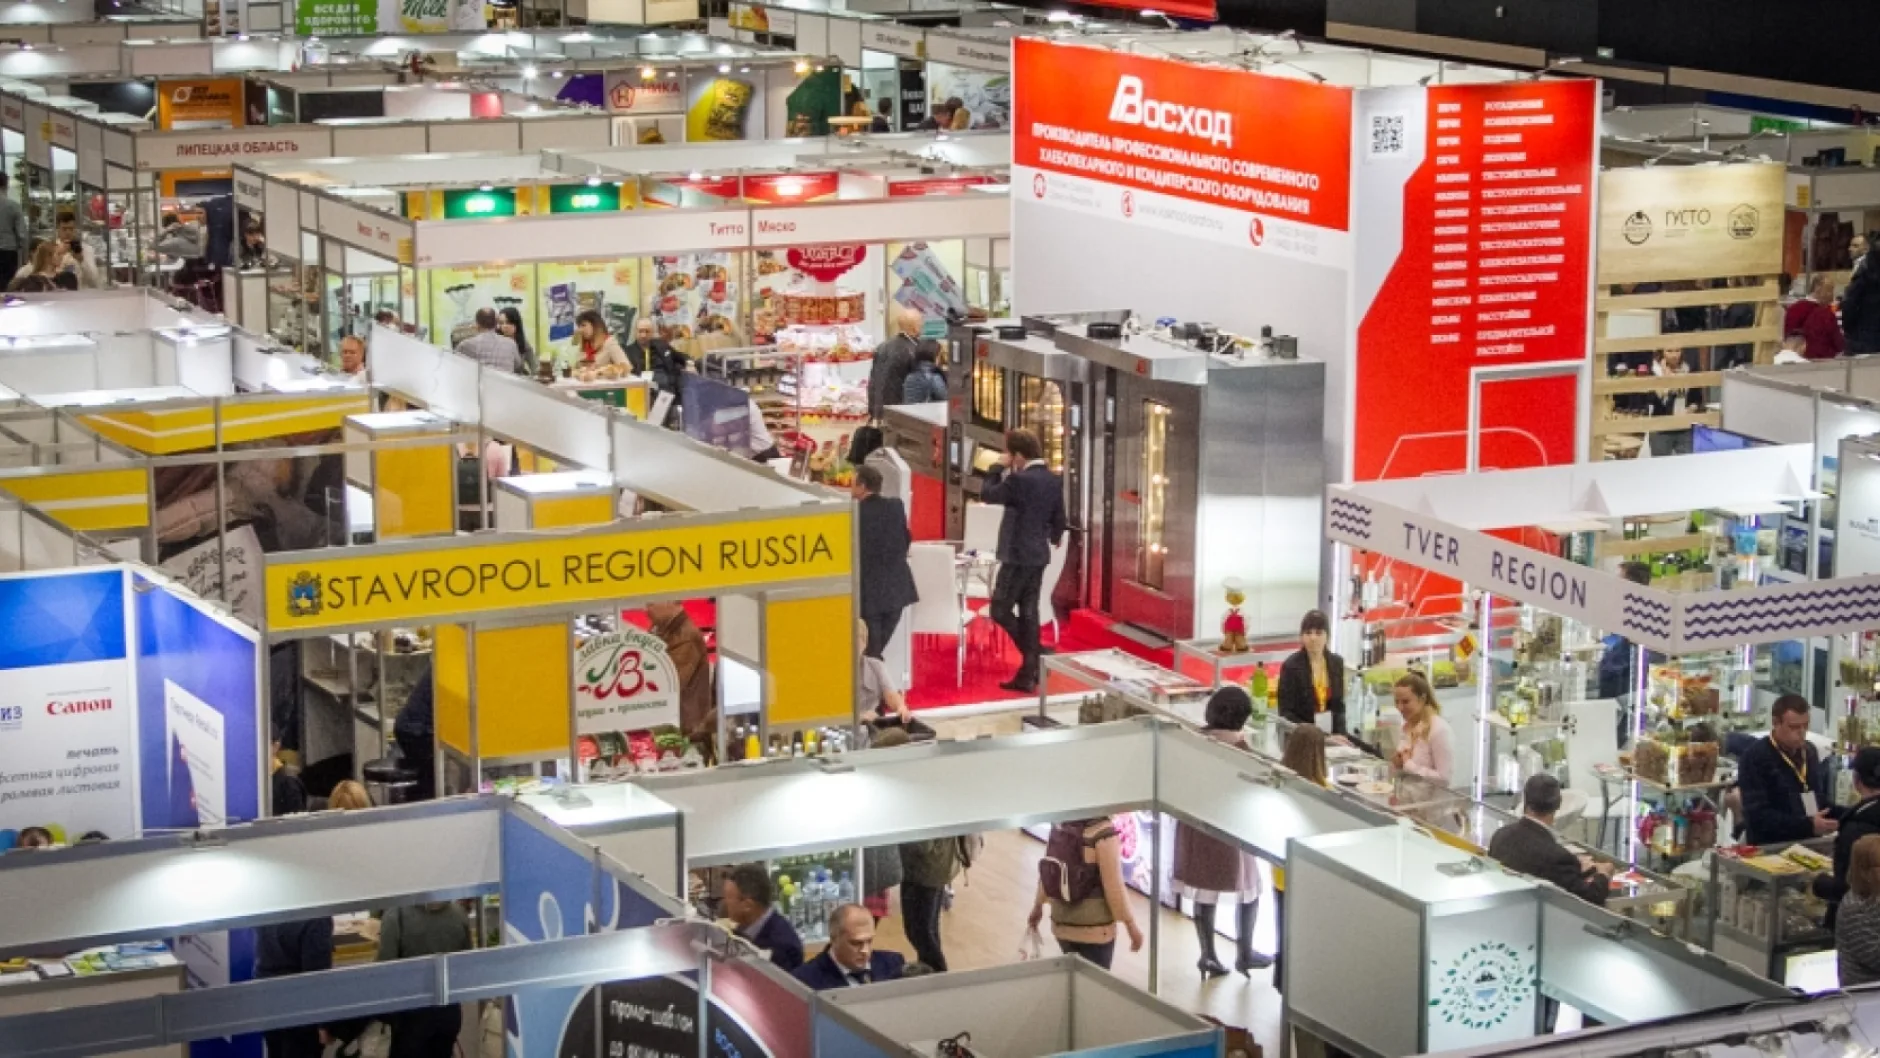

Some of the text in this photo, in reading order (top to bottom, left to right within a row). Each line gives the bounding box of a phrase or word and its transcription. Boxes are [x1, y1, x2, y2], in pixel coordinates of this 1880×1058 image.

[176, 140, 299, 157] ЛИПЕЦКАЯ ОБЛАСТЬ
[1032, 122, 1319, 191] ПРОИЗВОДИТЕЛЬ ПРОФЕССИОНАЛЬНОГО СОВРЕМЕННОГО
[1039, 148, 1310, 215] ХЛЕБОПЕКАРНОГО И КОНДИТЕРСКОГО ОБОРУДОВАНИЯ
[1665, 208, 1711, 226] ГУСТО
[709, 222, 744, 235] Титто
[327, 532, 833, 610] STAVROPOL REGION RUSSIA
[1403, 521, 1588, 608] TVER REGION
[46, 697, 113, 716] Canon
[66, 746, 119, 760] печать
[56, 763, 120, 780] цифровая
[56, 780, 120, 796] листовая
